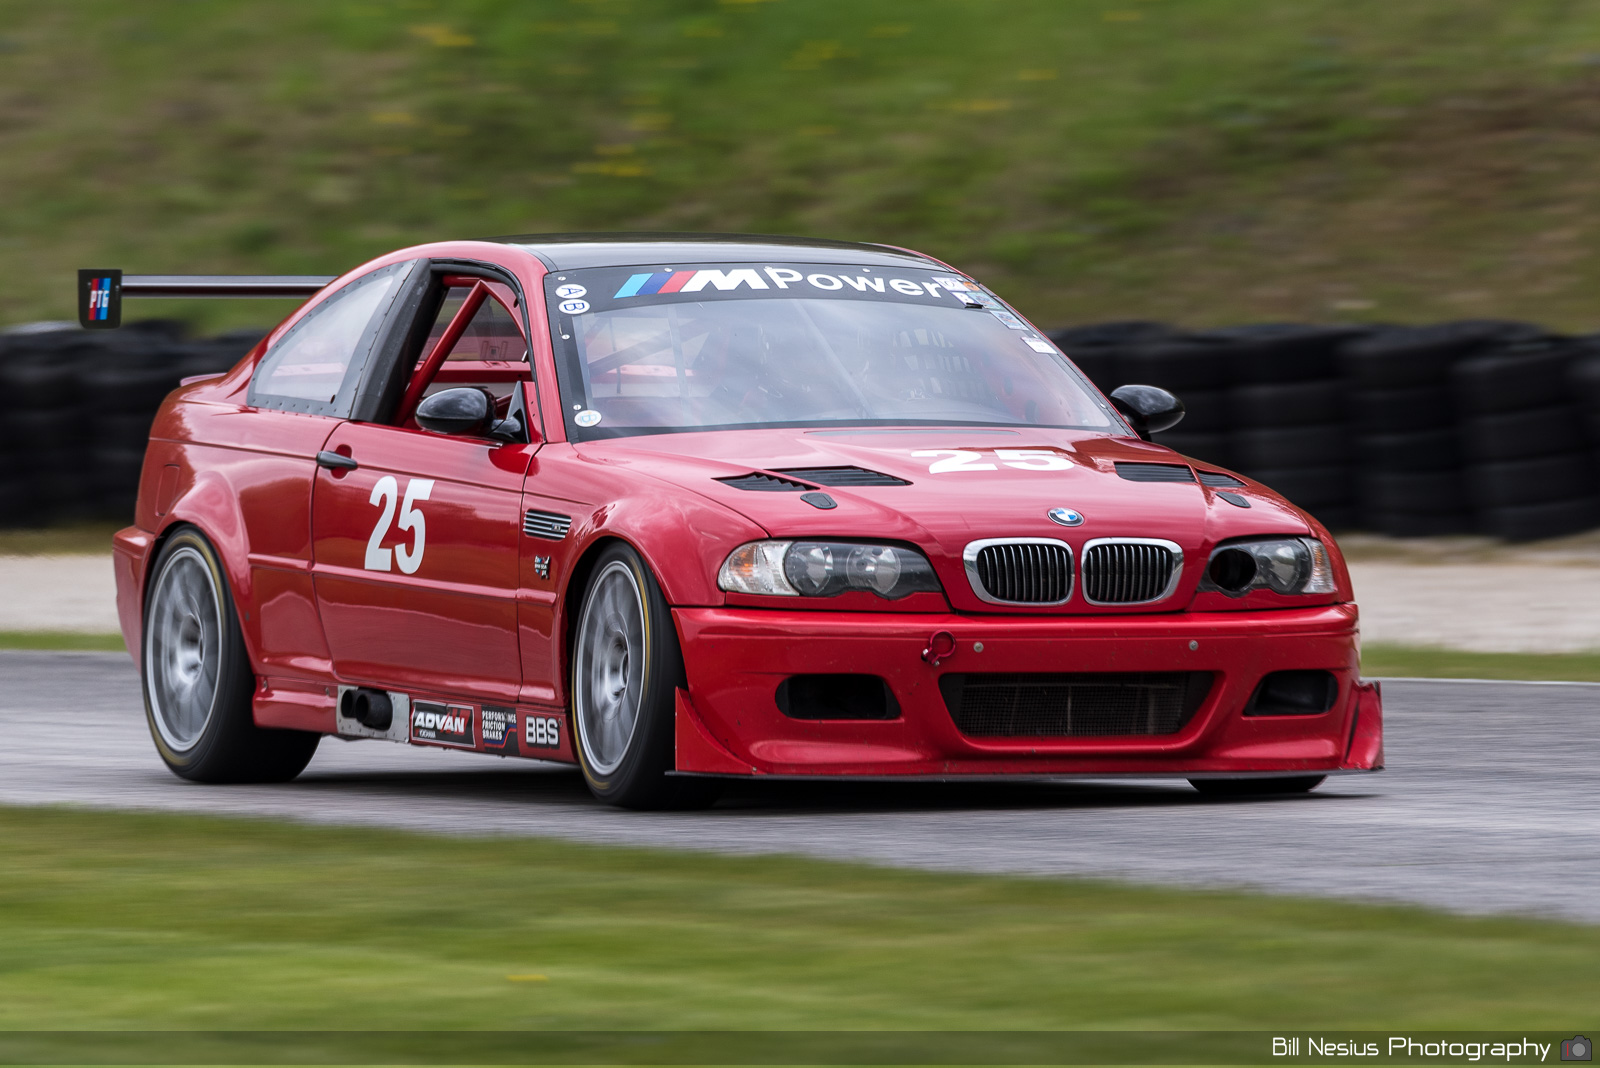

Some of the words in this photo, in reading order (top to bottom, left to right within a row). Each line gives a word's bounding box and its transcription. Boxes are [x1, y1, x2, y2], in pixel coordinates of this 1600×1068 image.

[561, 287, 583, 297] A
[563, 302, 585, 312] B
[911, 449, 1075, 474] 25
[364, 475, 436, 575] 25
[414, 711, 465, 733] ADVAN
[482, 720, 506, 731] FRICTION
[482, 729, 503, 740] BRAKES
[525, 716, 559, 745] BBS
